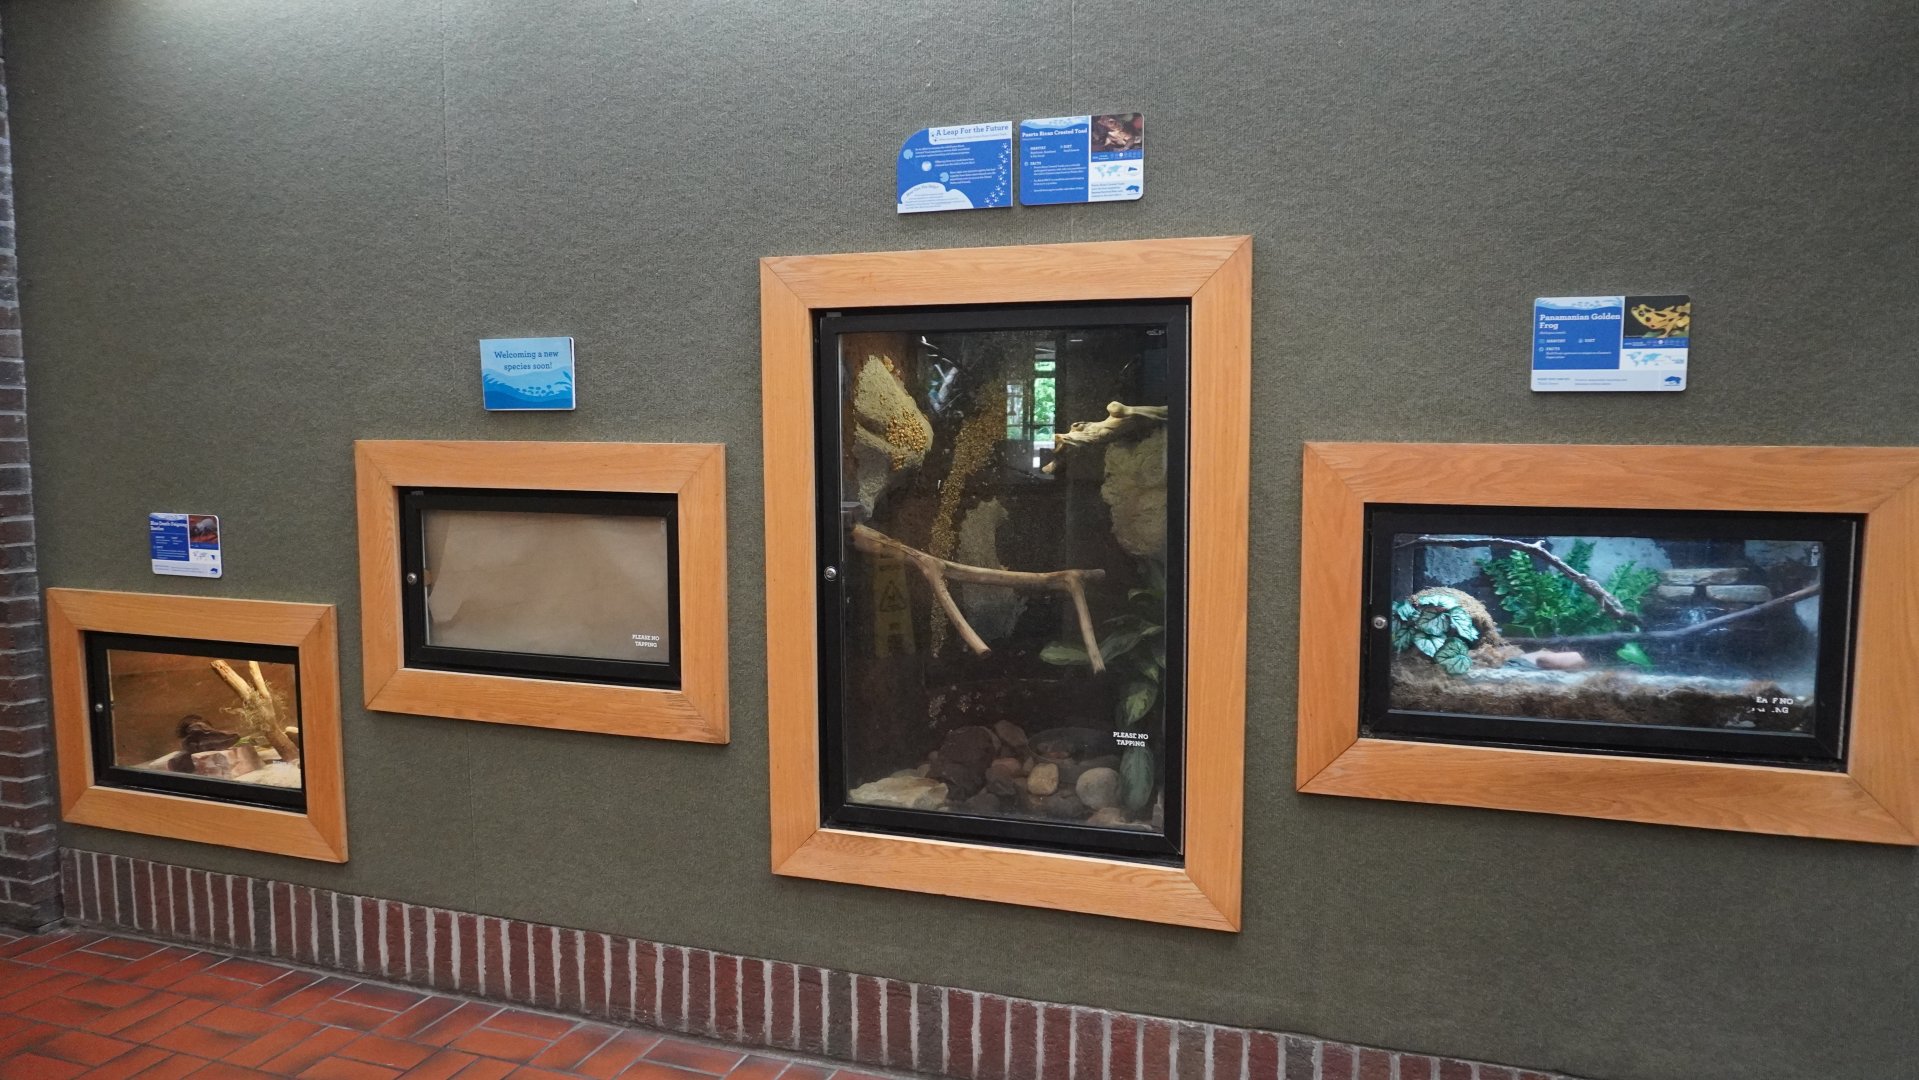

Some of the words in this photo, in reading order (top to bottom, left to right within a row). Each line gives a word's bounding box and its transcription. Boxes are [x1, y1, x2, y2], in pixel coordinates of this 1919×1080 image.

[1591, 312, 1620, 320] Golden
[1539, 322, 1558, 330] Frog
[494, 350, 536, 359] Welcoming
[504, 362, 531, 372] species
[1779, 697, 1794, 705] NO
[1113, 731, 1137, 739] PLEASE
[1116, 739, 1145, 747] TAPPING
